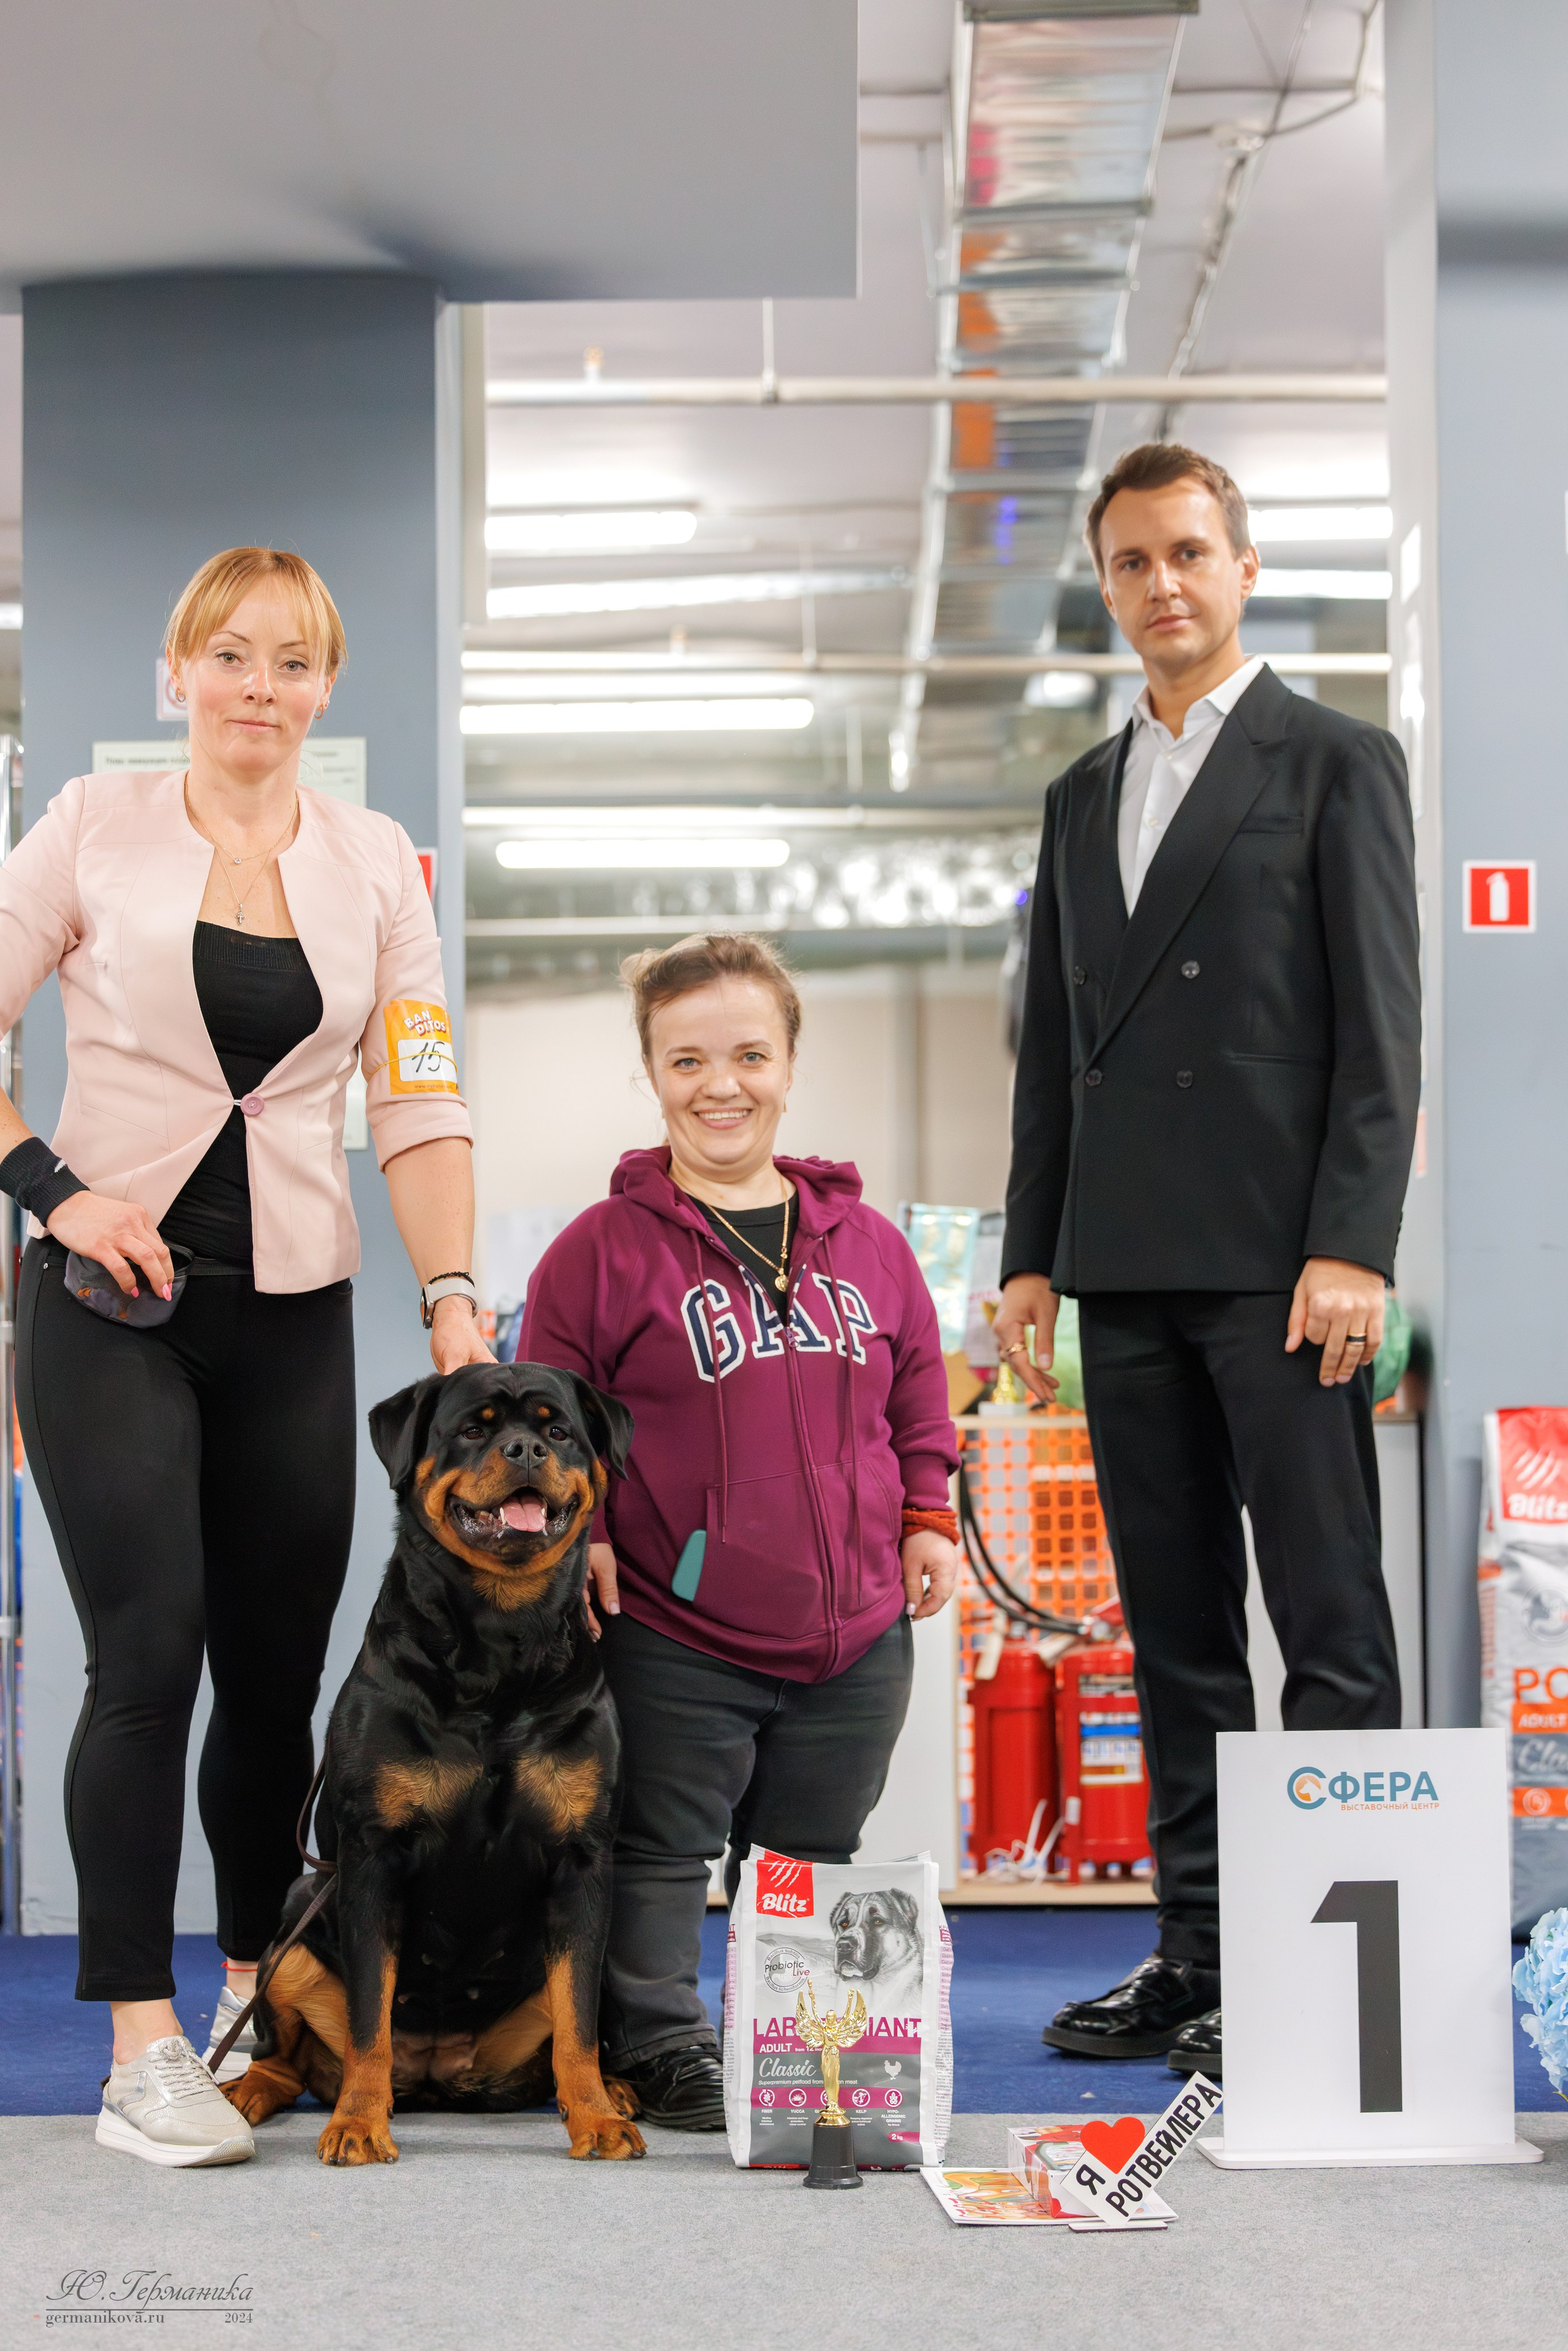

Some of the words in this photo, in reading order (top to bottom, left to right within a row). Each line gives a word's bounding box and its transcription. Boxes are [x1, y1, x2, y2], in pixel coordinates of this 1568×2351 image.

[404, 1010, 432, 1030] BAN
[415, 1020, 447, 1036] DITOS
[411, 1041, 445, 1073] 15
[680, 1264, 878, 1383] GAP
[1287, 1766, 1439, 1810] СФЕРА
[1341, 1802, 1409, 1811] ВЫСТАВОЧНЫЙ
[761, 1893, 807, 1912] Blitz
[764, 1960, 804, 1972] Probiotic
[793, 1966, 810, 1976] Live
[1310, 1879, 1403, 2113] 1
[760, 2043, 793, 2053] ADULT
[759, 2057, 816, 2077] Classic
[1076, 2164, 1106, 2195] Я
[1105, 2083, 1223, 2217] РОТВЕЙЛЕРА
